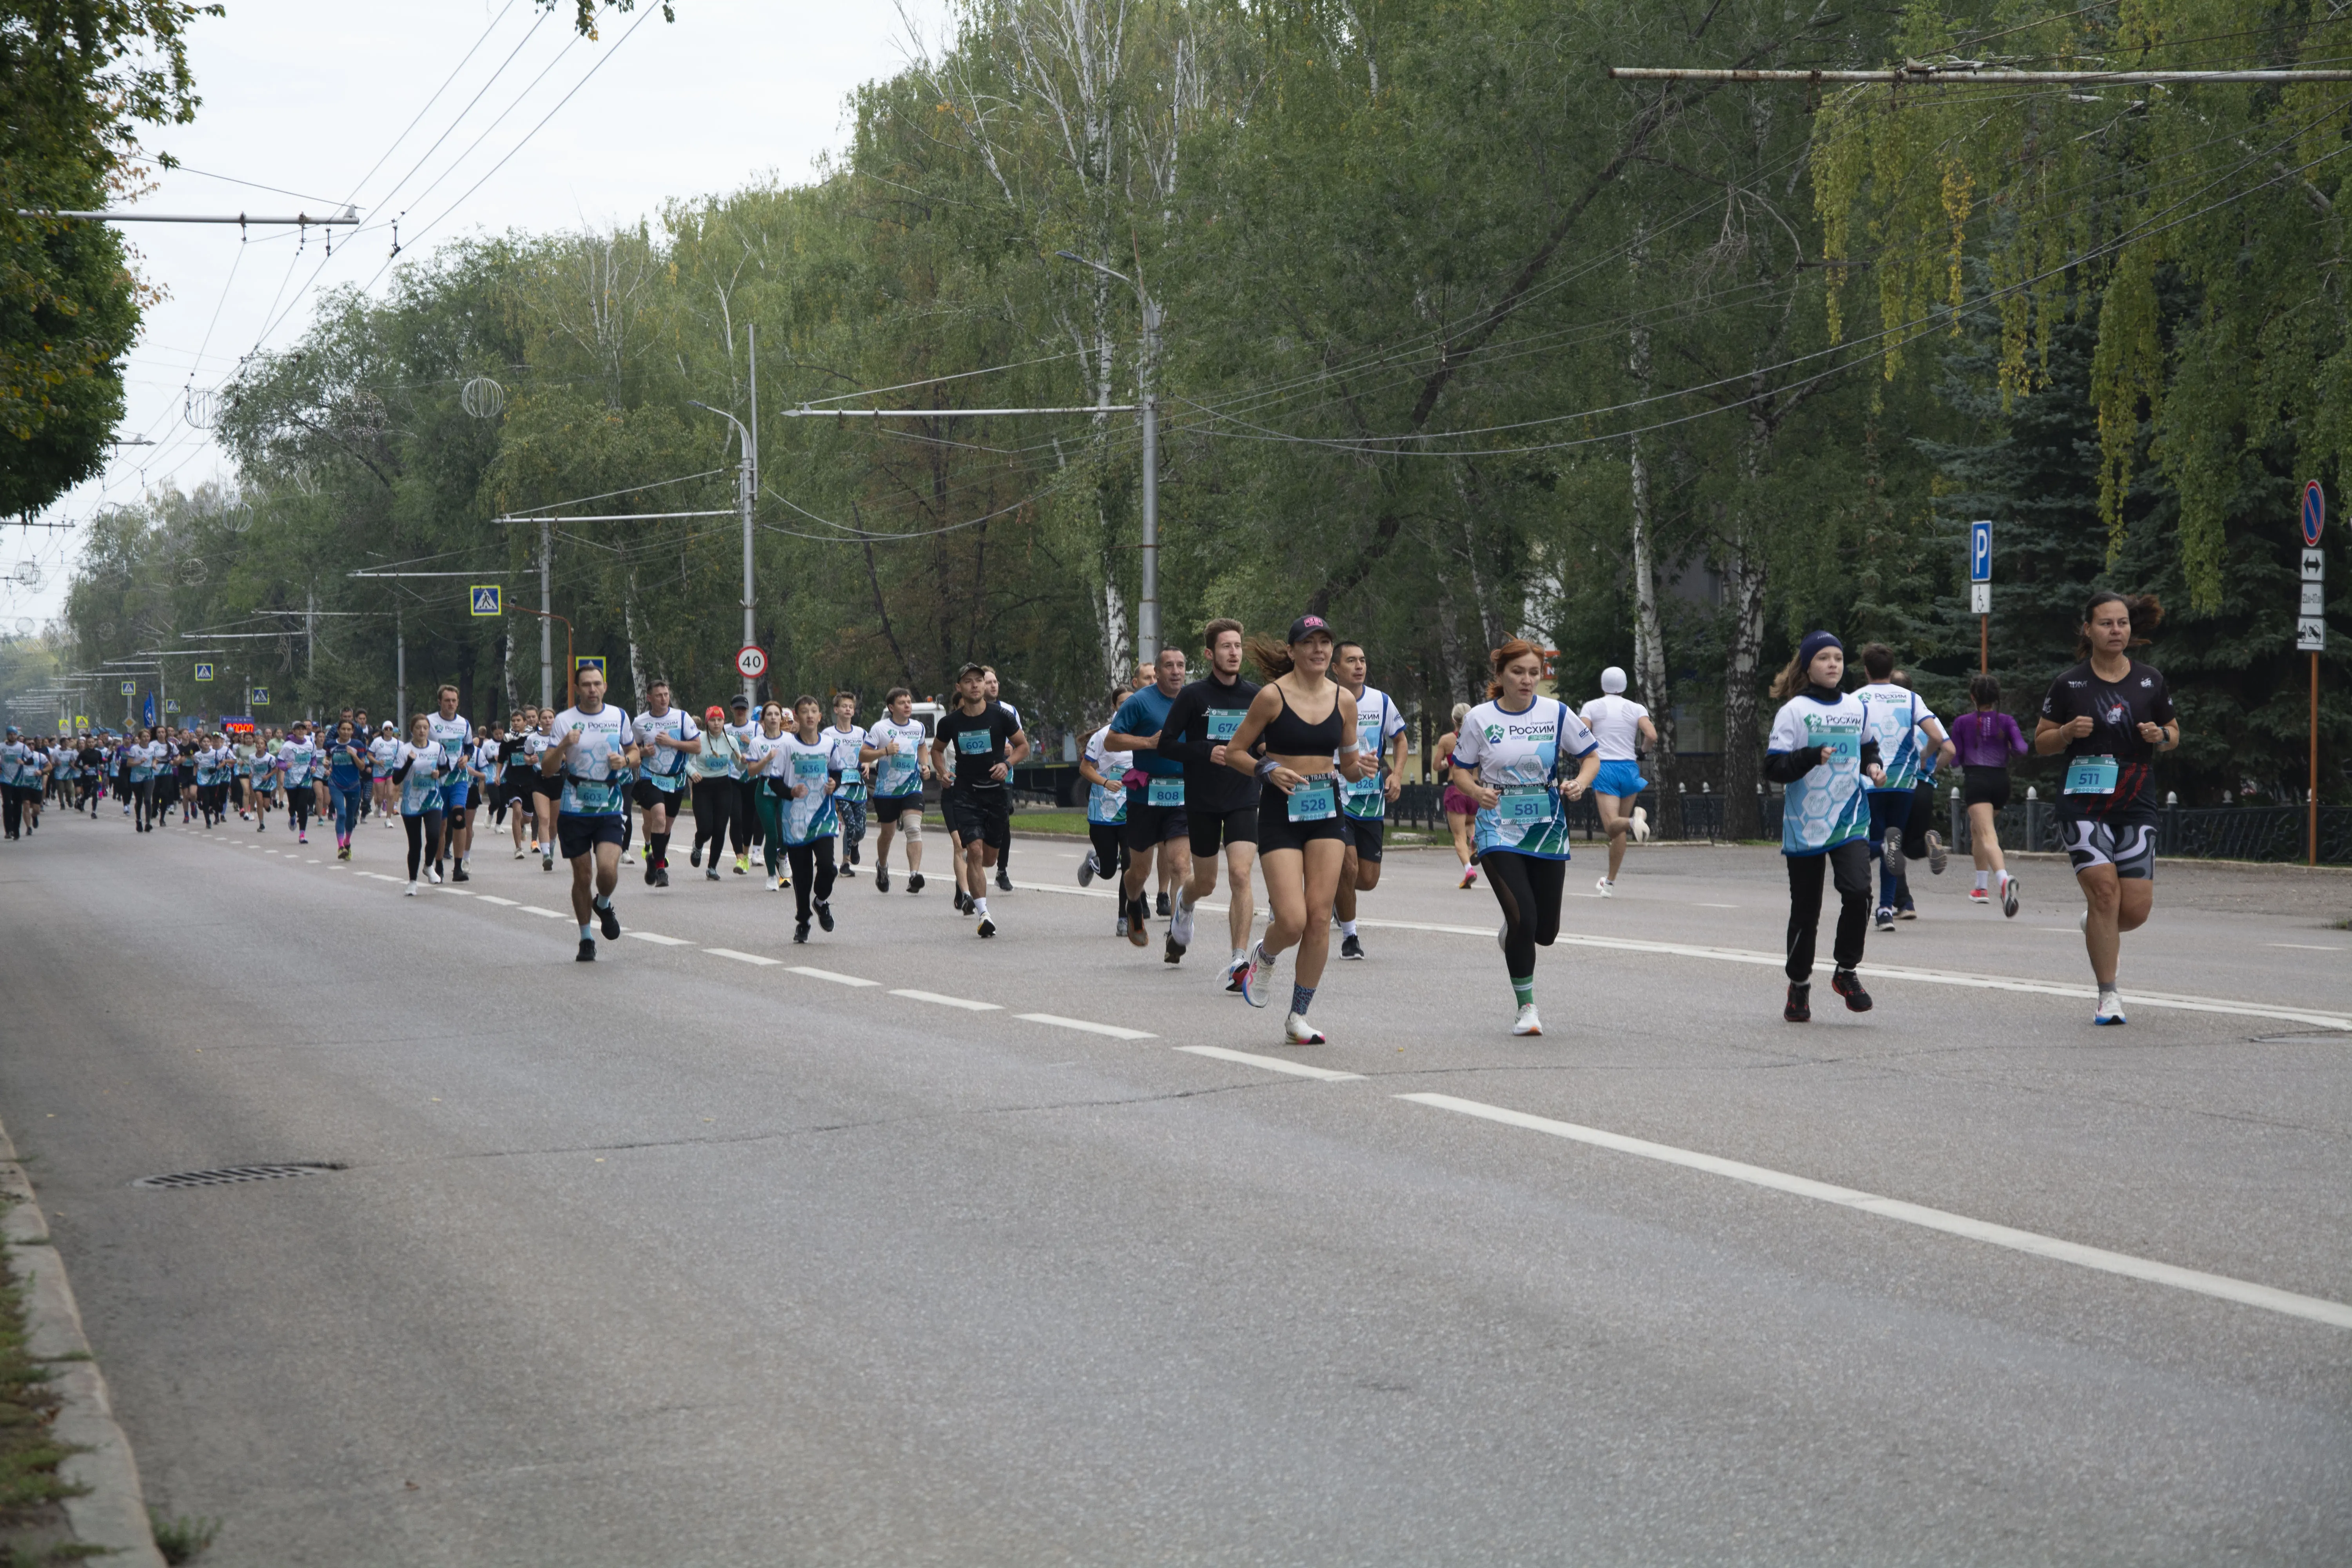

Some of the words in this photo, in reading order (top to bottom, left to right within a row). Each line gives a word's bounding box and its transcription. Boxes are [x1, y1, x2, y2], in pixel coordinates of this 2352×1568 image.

[1976, 529, 1988, 574] P
[742, 655, 761, 668] 40
[966, 741, 985, 750] 602
[802, 764, 819, 773] 536
[1311, 773, 1327, 781] TRAIL
[2078, 773, 2100, 785] 511
[1356, 779, 1374, 789] 826
[584, 792, 601, 802] 603
[1157, 791, 1179, 800] 808
[1301, 798, 1326, 811] 528
[1515, 803, 1539, 816] 581
